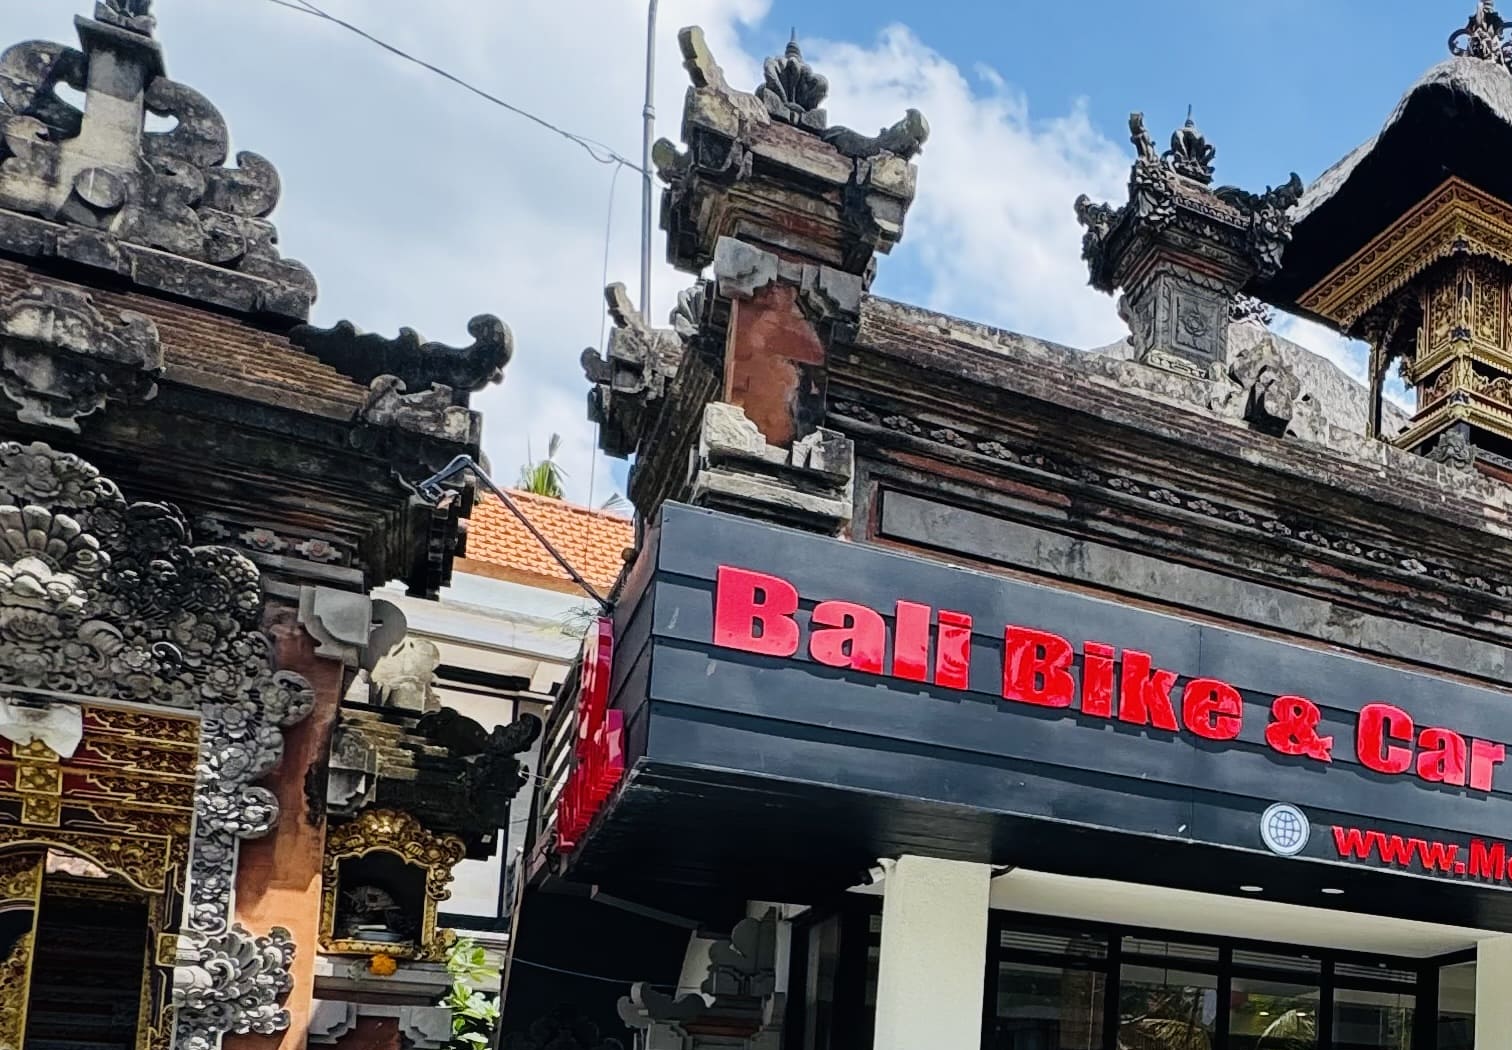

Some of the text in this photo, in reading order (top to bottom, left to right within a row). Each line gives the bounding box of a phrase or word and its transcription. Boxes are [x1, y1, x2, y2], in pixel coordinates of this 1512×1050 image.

[713, 564, 973, 691] Bali
[1003, 624, 1244, 741] Bike
[1264, 694, 1333, 762] &
[1356, 702, 1504, 793] Car
